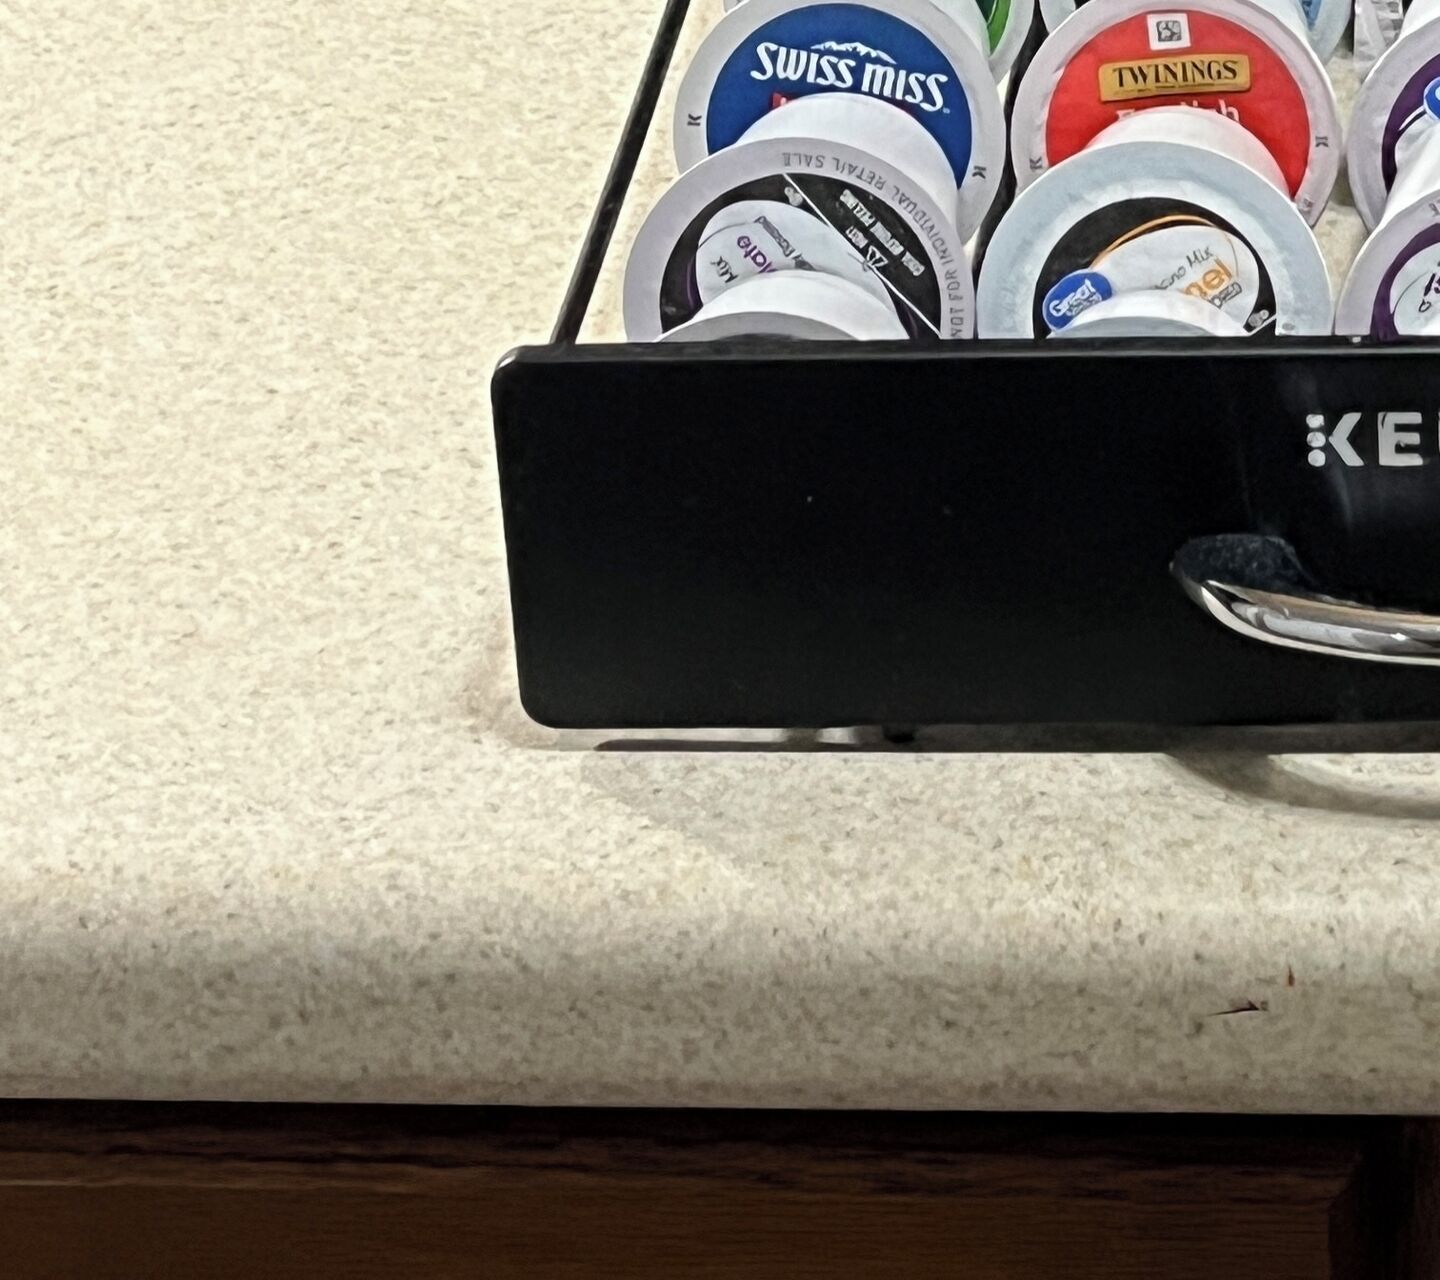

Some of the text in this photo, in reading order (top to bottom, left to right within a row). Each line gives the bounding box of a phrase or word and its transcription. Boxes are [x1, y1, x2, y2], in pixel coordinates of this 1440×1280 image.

[750, 42, 949, 113] SWISS MISS
[1112, 59, 1239, 88] TWININGS
[782, 152, 826, 169] SALE
[831, 156, 888, 190] RETAIL
